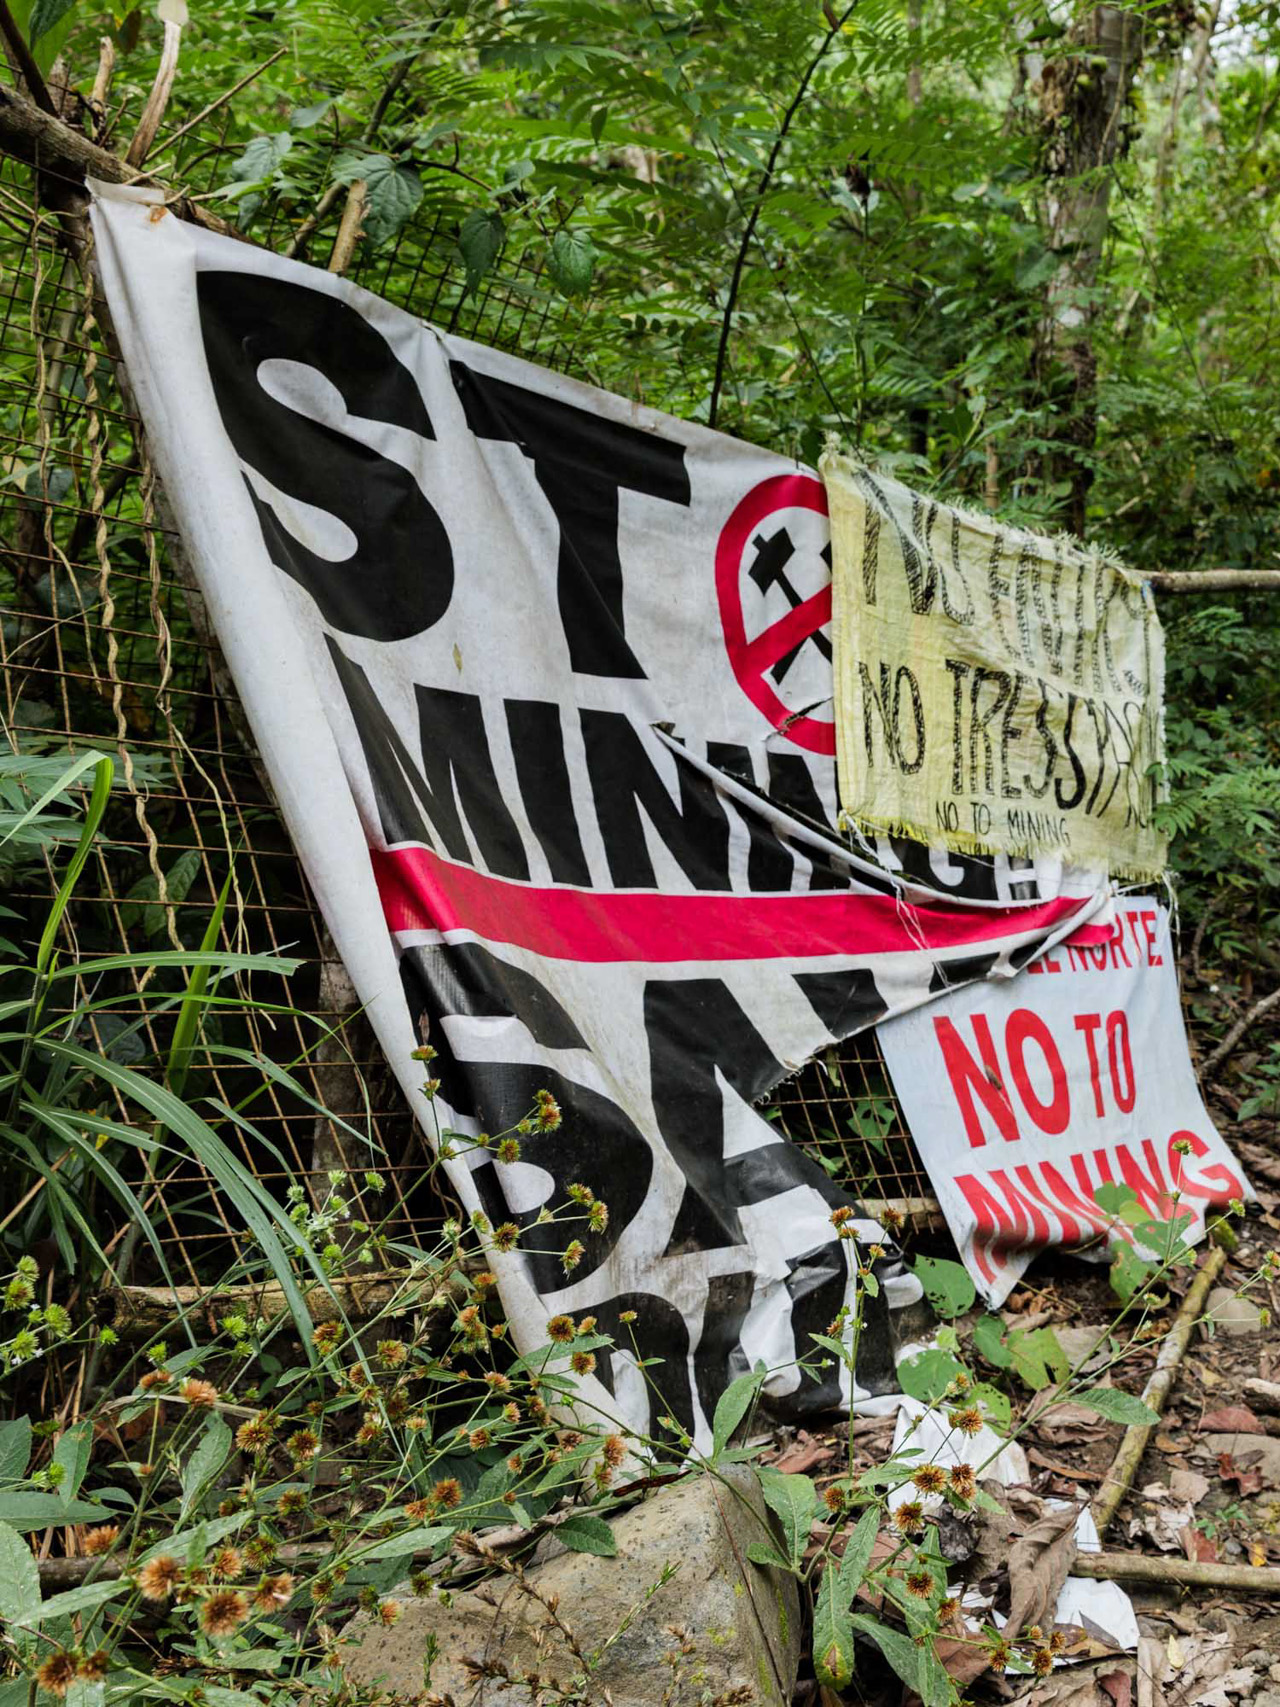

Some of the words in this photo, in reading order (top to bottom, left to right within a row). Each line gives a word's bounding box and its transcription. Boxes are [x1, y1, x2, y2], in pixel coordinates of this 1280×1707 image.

[858, 660, 927, 777] NO
[935, 800, 960, 834] NO
[969, 801, 992, 836] TO
[1007, 808, 1071, 848] MINING
[932, 1008, 1070, 1148] NO
[1073, 1009, 1136, 1119] TO
[952, 1129, 1245, 1285] MINING
